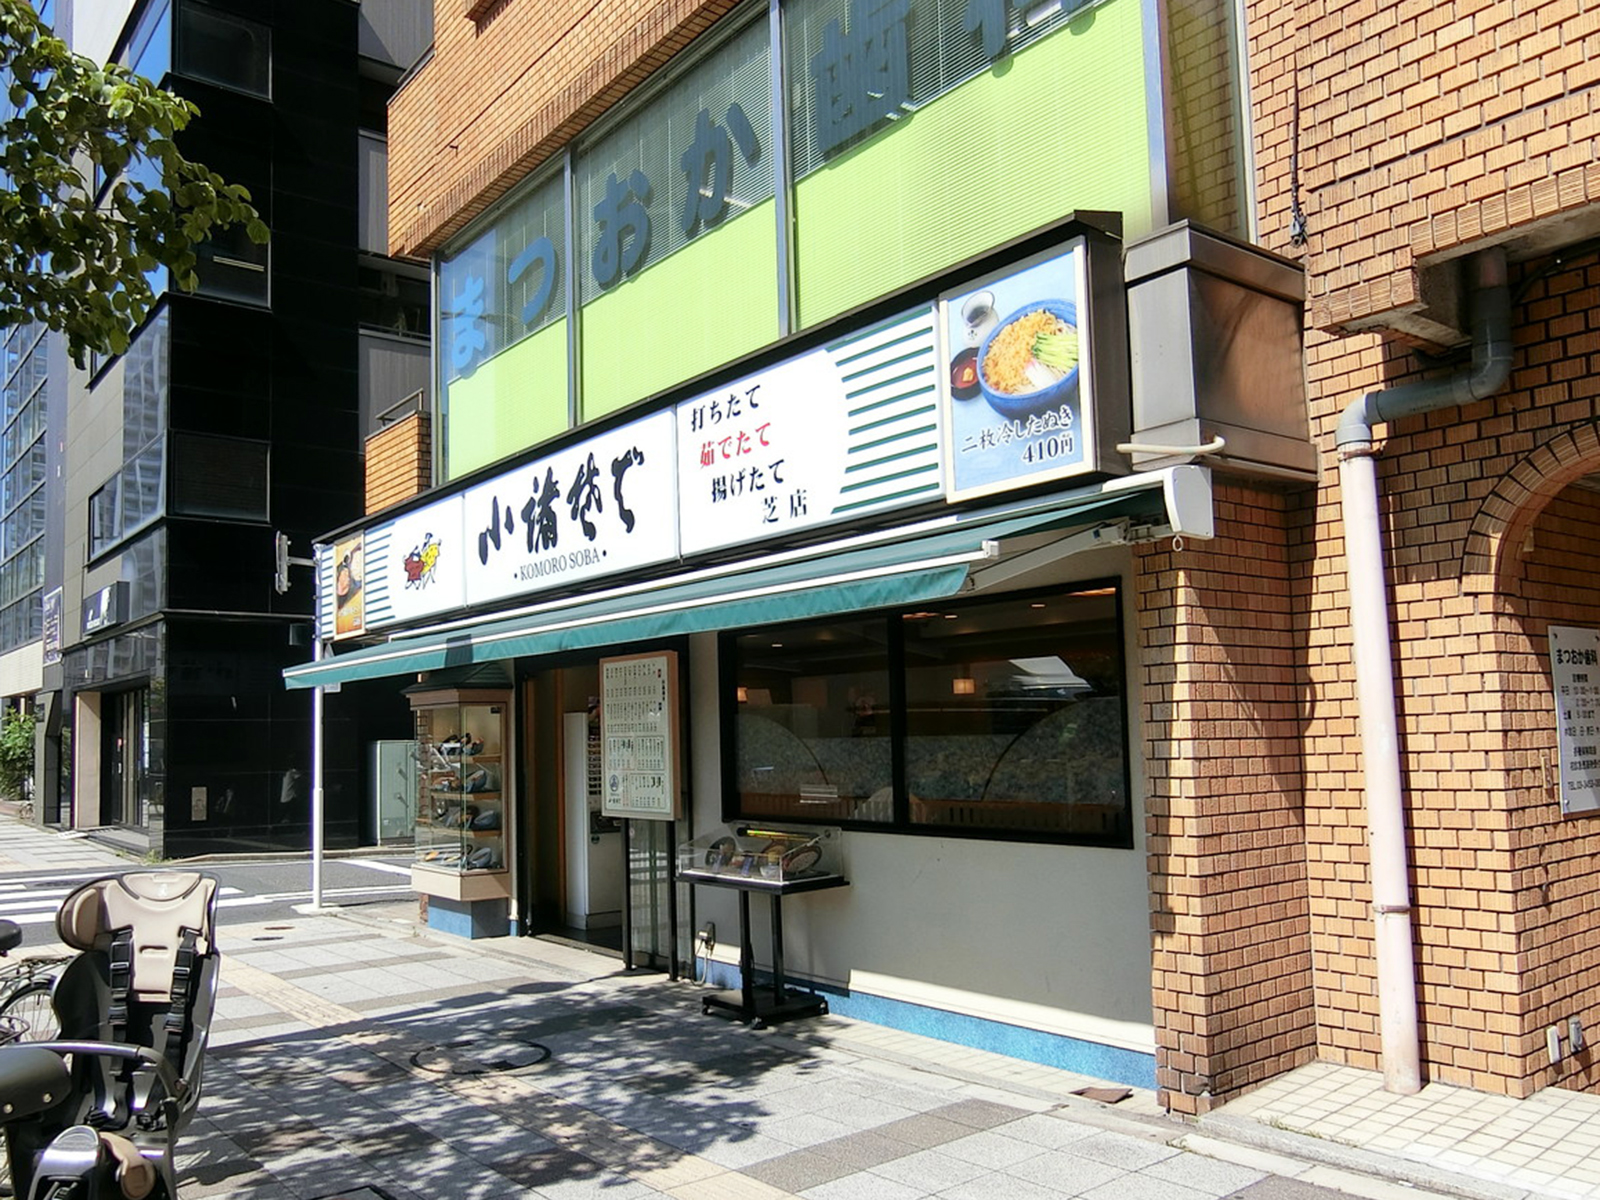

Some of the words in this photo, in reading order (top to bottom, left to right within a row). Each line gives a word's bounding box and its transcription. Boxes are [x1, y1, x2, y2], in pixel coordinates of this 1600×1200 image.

[691, 384, 761, 433] 打ちたて
[961, 406, 1074, 453] 二枚冷したぬき
[699, 422, 772, 470] 茹でたて
[1022, 438, 1074, 463] 410円
[711, 459, 785, 503] 揚げたて
[519, 553, 568, 582] KOMORO
[568, 547, 601, 570] SOBA
